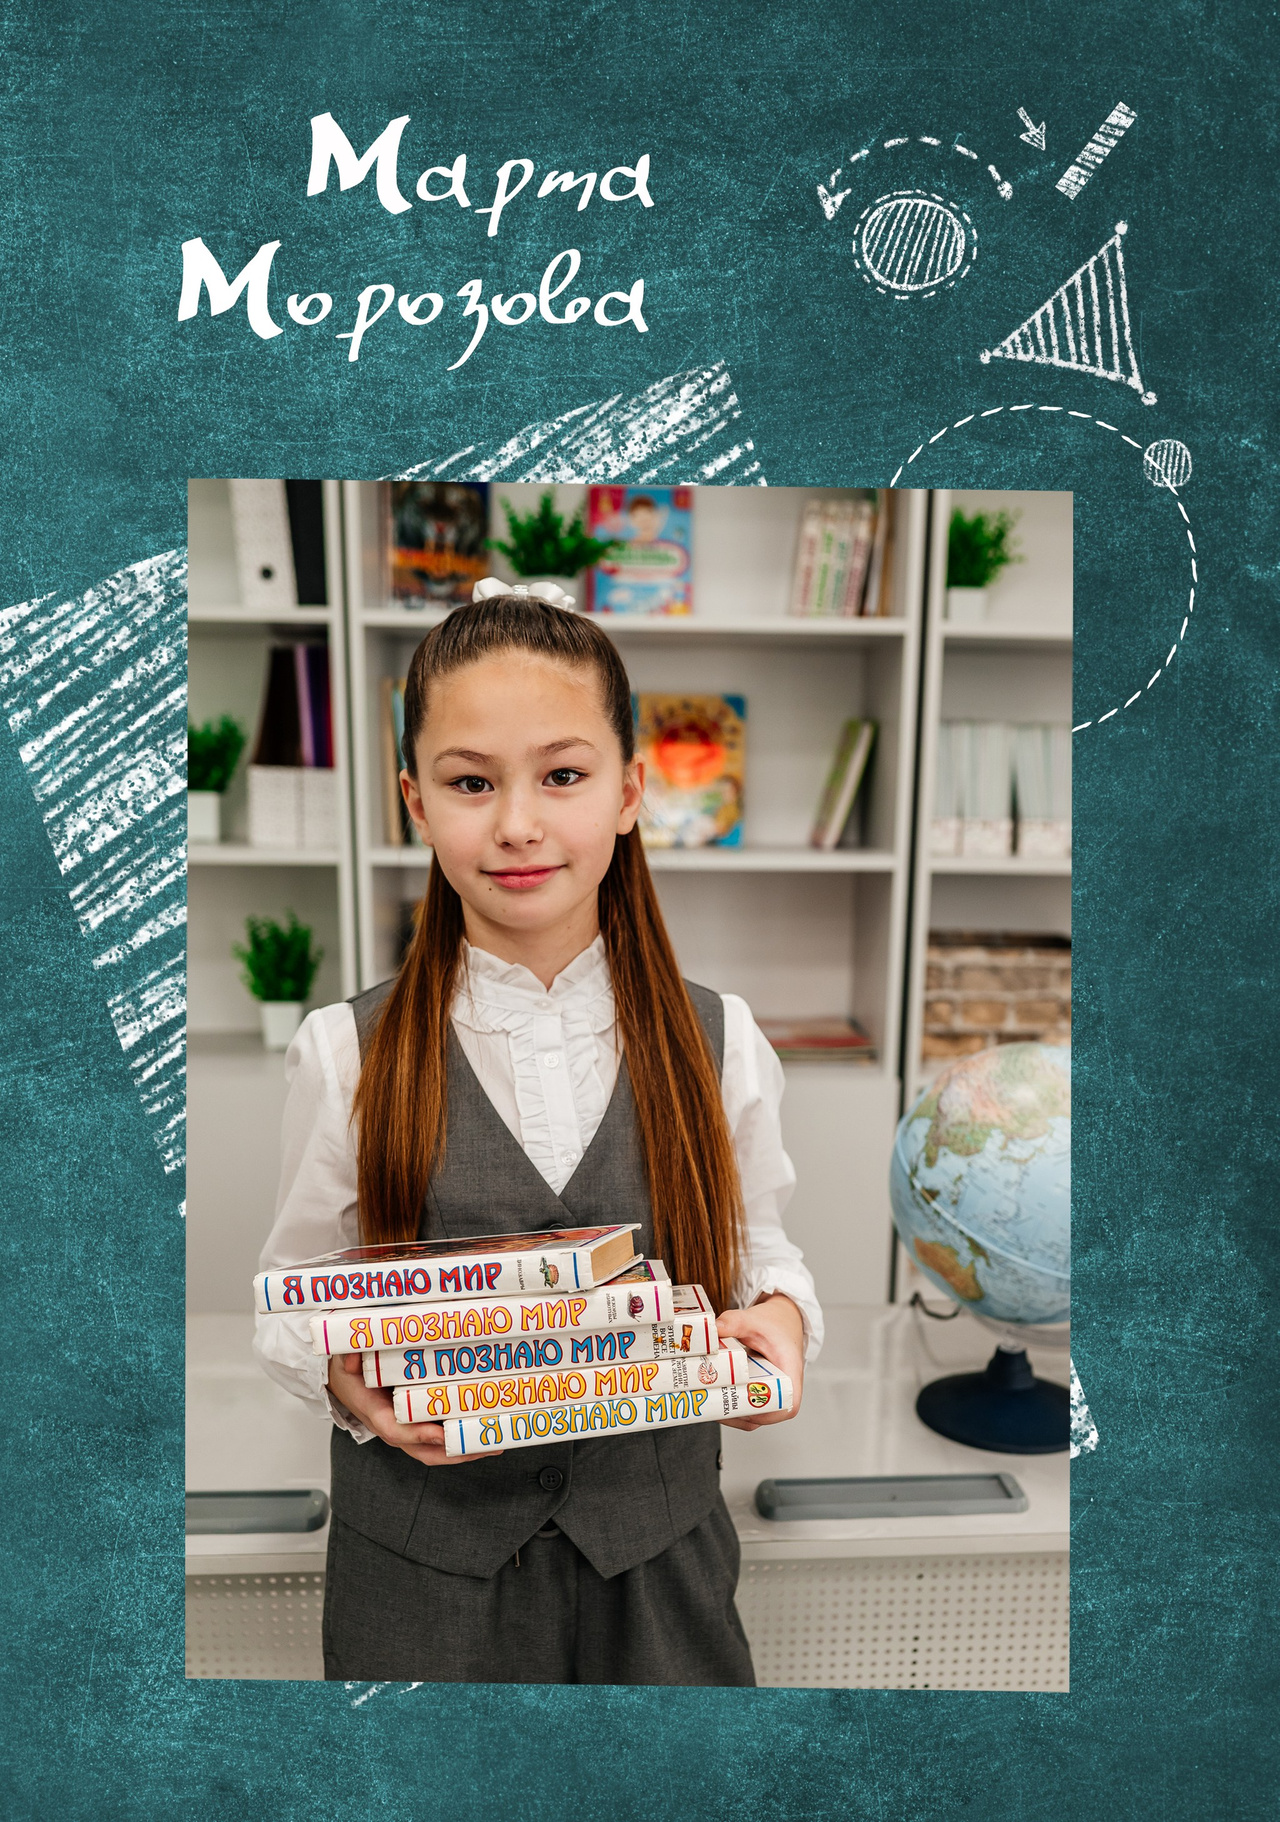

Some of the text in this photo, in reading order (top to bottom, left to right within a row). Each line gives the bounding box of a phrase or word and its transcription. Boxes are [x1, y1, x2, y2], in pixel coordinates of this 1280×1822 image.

[282, 1262, 502, 1306] Я ПОЗНАЮ МИР
[349, 1297, 587, 1350] Я ПОЗНАЮ МИР
[651, 1323, 660, 1360] ВРЕМЕНА
[659, 1328, 668, 1354] ВО ВСЕ
[667, 1325, 676, 1355] ЭТИКЕТ
[403, 1329, 636, 1381] Я ПОЗНАЮ МИР
[425, 1361, 660, 1416] Я ПОЗНАЮ МИР
[721, 1386, 730, 1417] ЕЛОВЕКА
[730, 1386, 739, 1411] ТАЙНЫ
[478, 1388, 709, 1446] Я ПОЗНАЮ МИР
